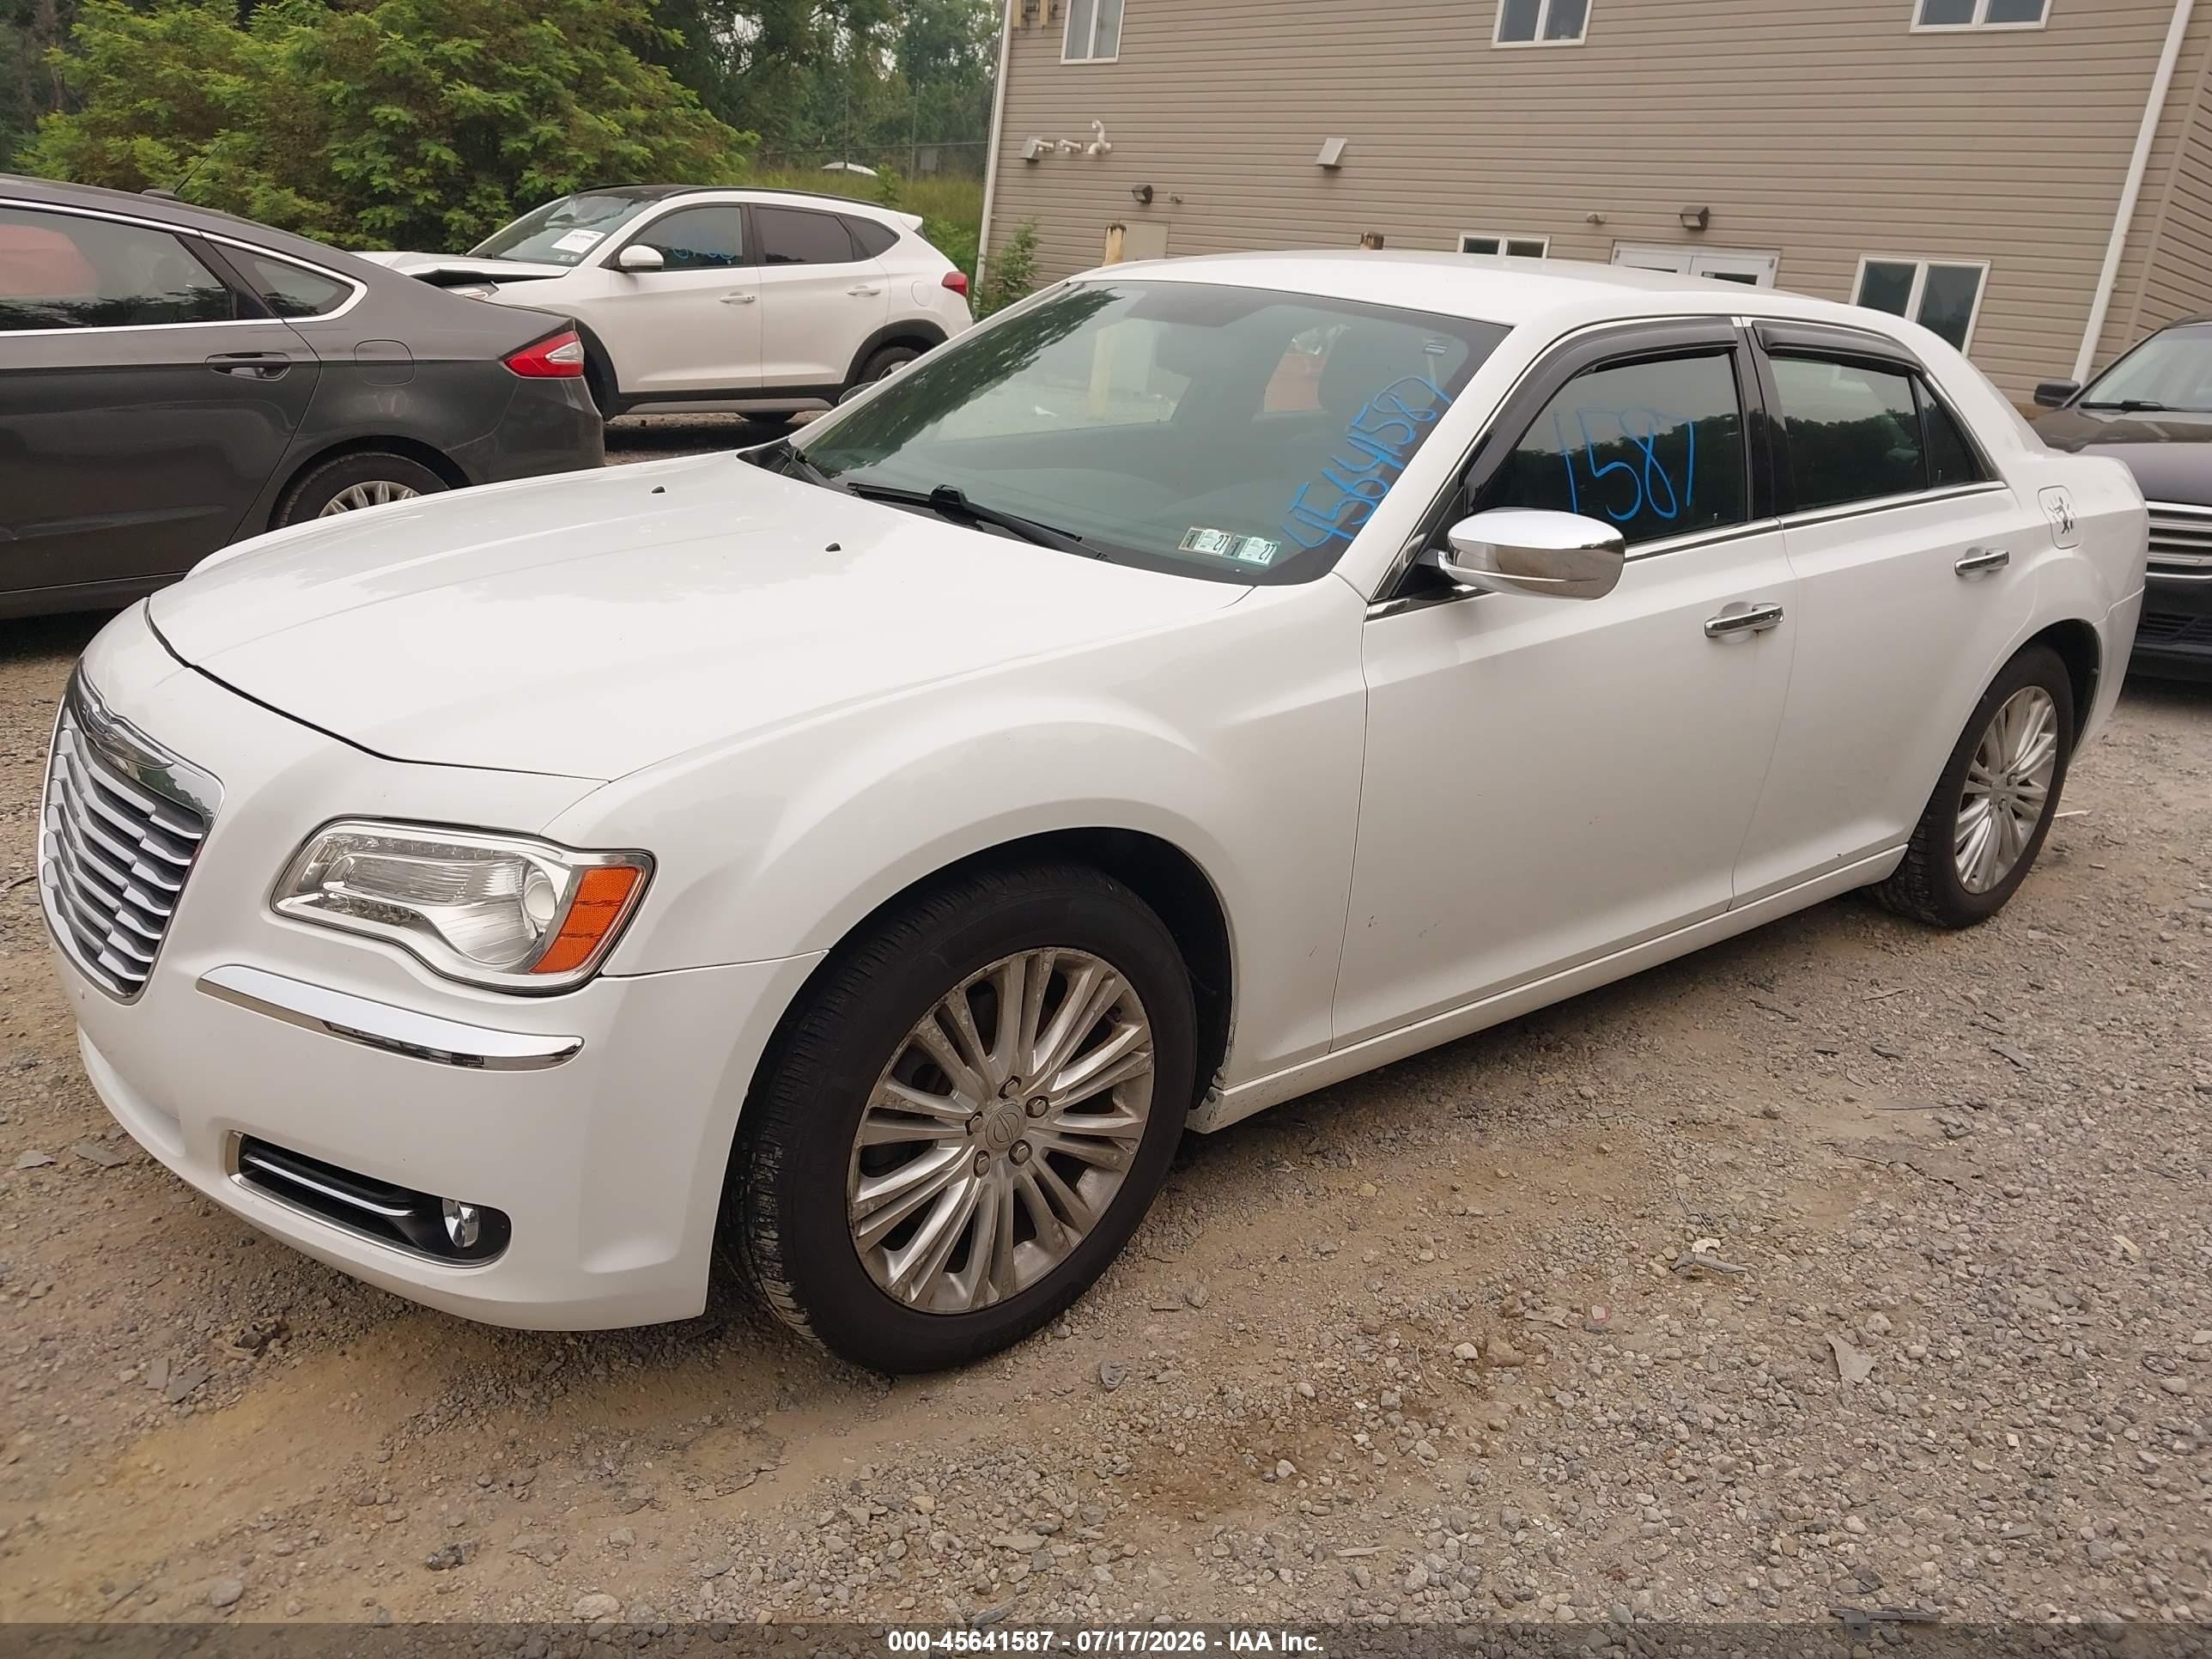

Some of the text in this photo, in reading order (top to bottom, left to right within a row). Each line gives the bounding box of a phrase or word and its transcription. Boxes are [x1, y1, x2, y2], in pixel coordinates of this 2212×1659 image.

[1553, 406, 1695, 520] 1587
[1212, 533, 1230, 552] 27
[1258, 542, 1276, 562] 27
